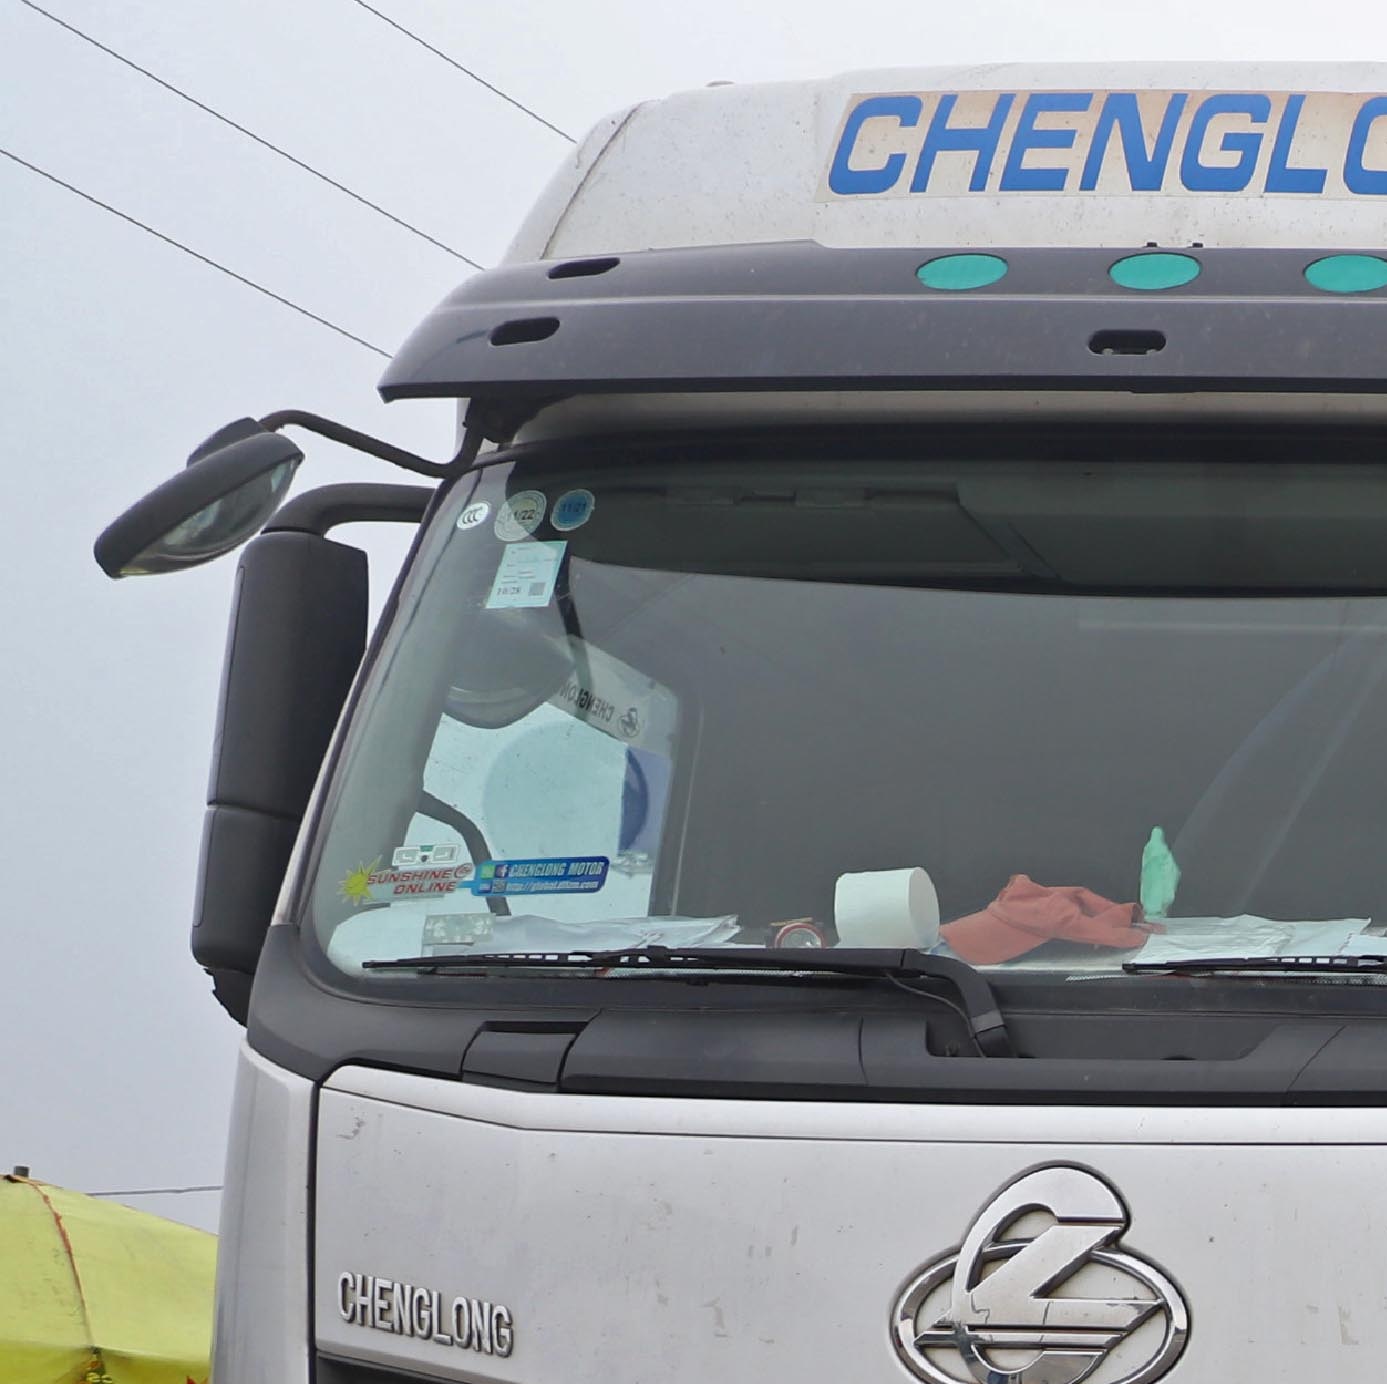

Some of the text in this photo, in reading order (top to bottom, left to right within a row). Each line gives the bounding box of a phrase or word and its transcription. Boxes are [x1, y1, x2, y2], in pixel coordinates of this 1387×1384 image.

[568, 861, 606, 876] MOTOR
[367, 869, 453, 885] SUNSHINE
[393, 881, 457, 895] ONLINE
[337, 1271, 515, 1359] CHENGLONG
